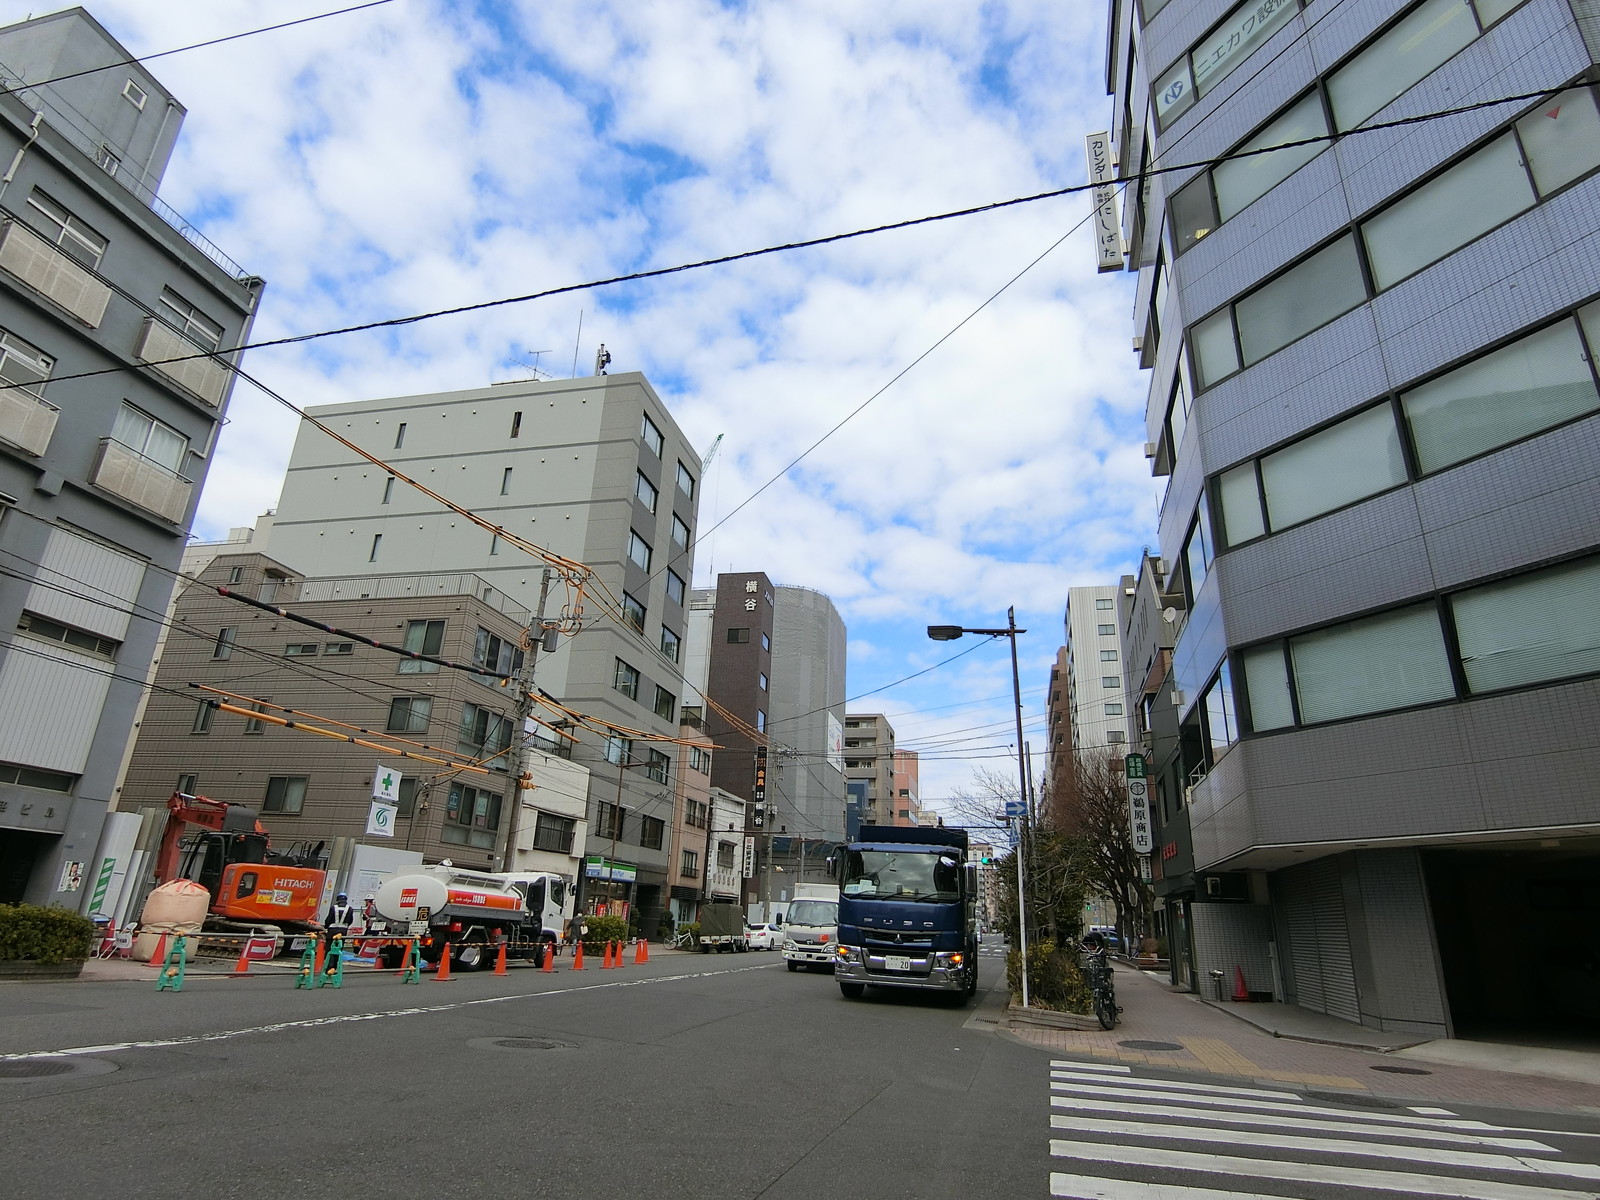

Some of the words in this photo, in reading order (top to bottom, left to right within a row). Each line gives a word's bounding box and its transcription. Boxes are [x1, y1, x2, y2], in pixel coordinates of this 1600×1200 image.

[1098, 206, 1117, 258] にしばた
[745, 580, 758, 611] 横谷
[274, 878, 315, 889] HITACHI
[417, 907, 429, 921] 危
[863, 917, 934, 927] FUSO
